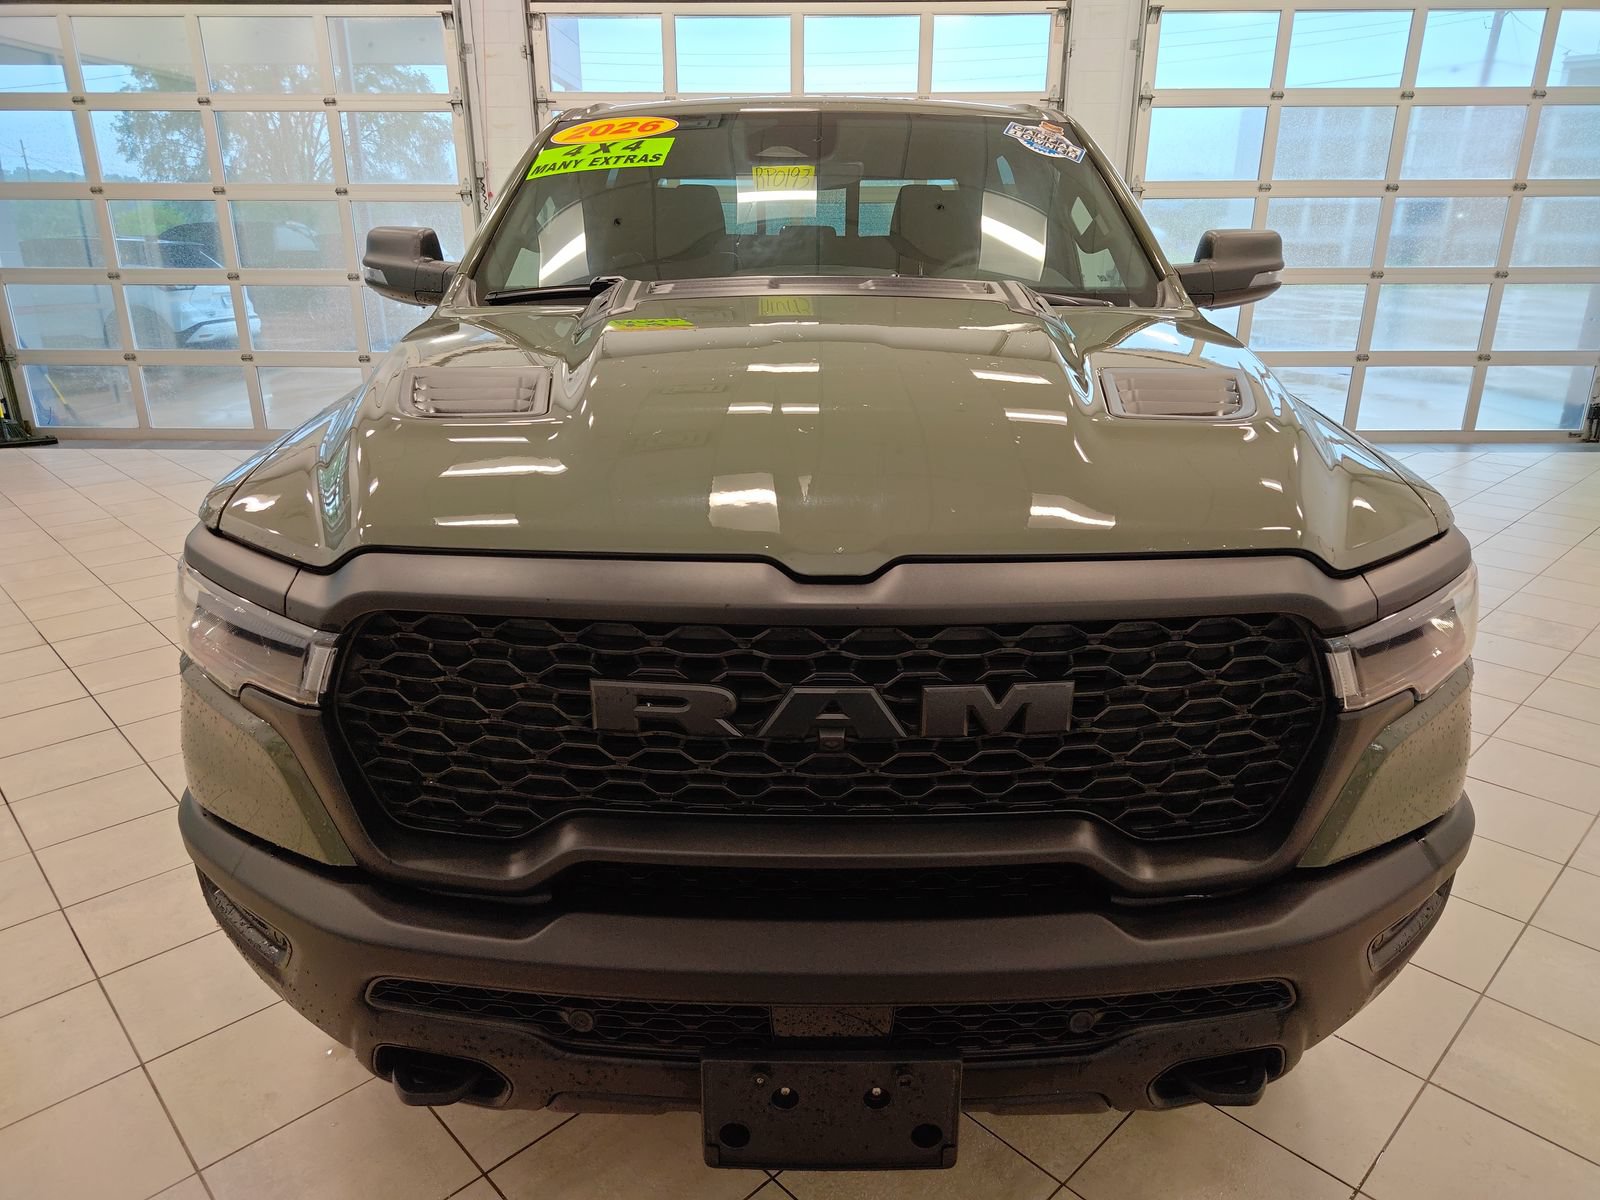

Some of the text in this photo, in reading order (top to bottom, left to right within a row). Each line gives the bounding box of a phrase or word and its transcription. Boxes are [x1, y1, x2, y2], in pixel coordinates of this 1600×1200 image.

[563, 121, 665, 141] 2026
[530, 153, 663, 176] MANY EXTRAS
[590, 679, 1076, 738] RAM
